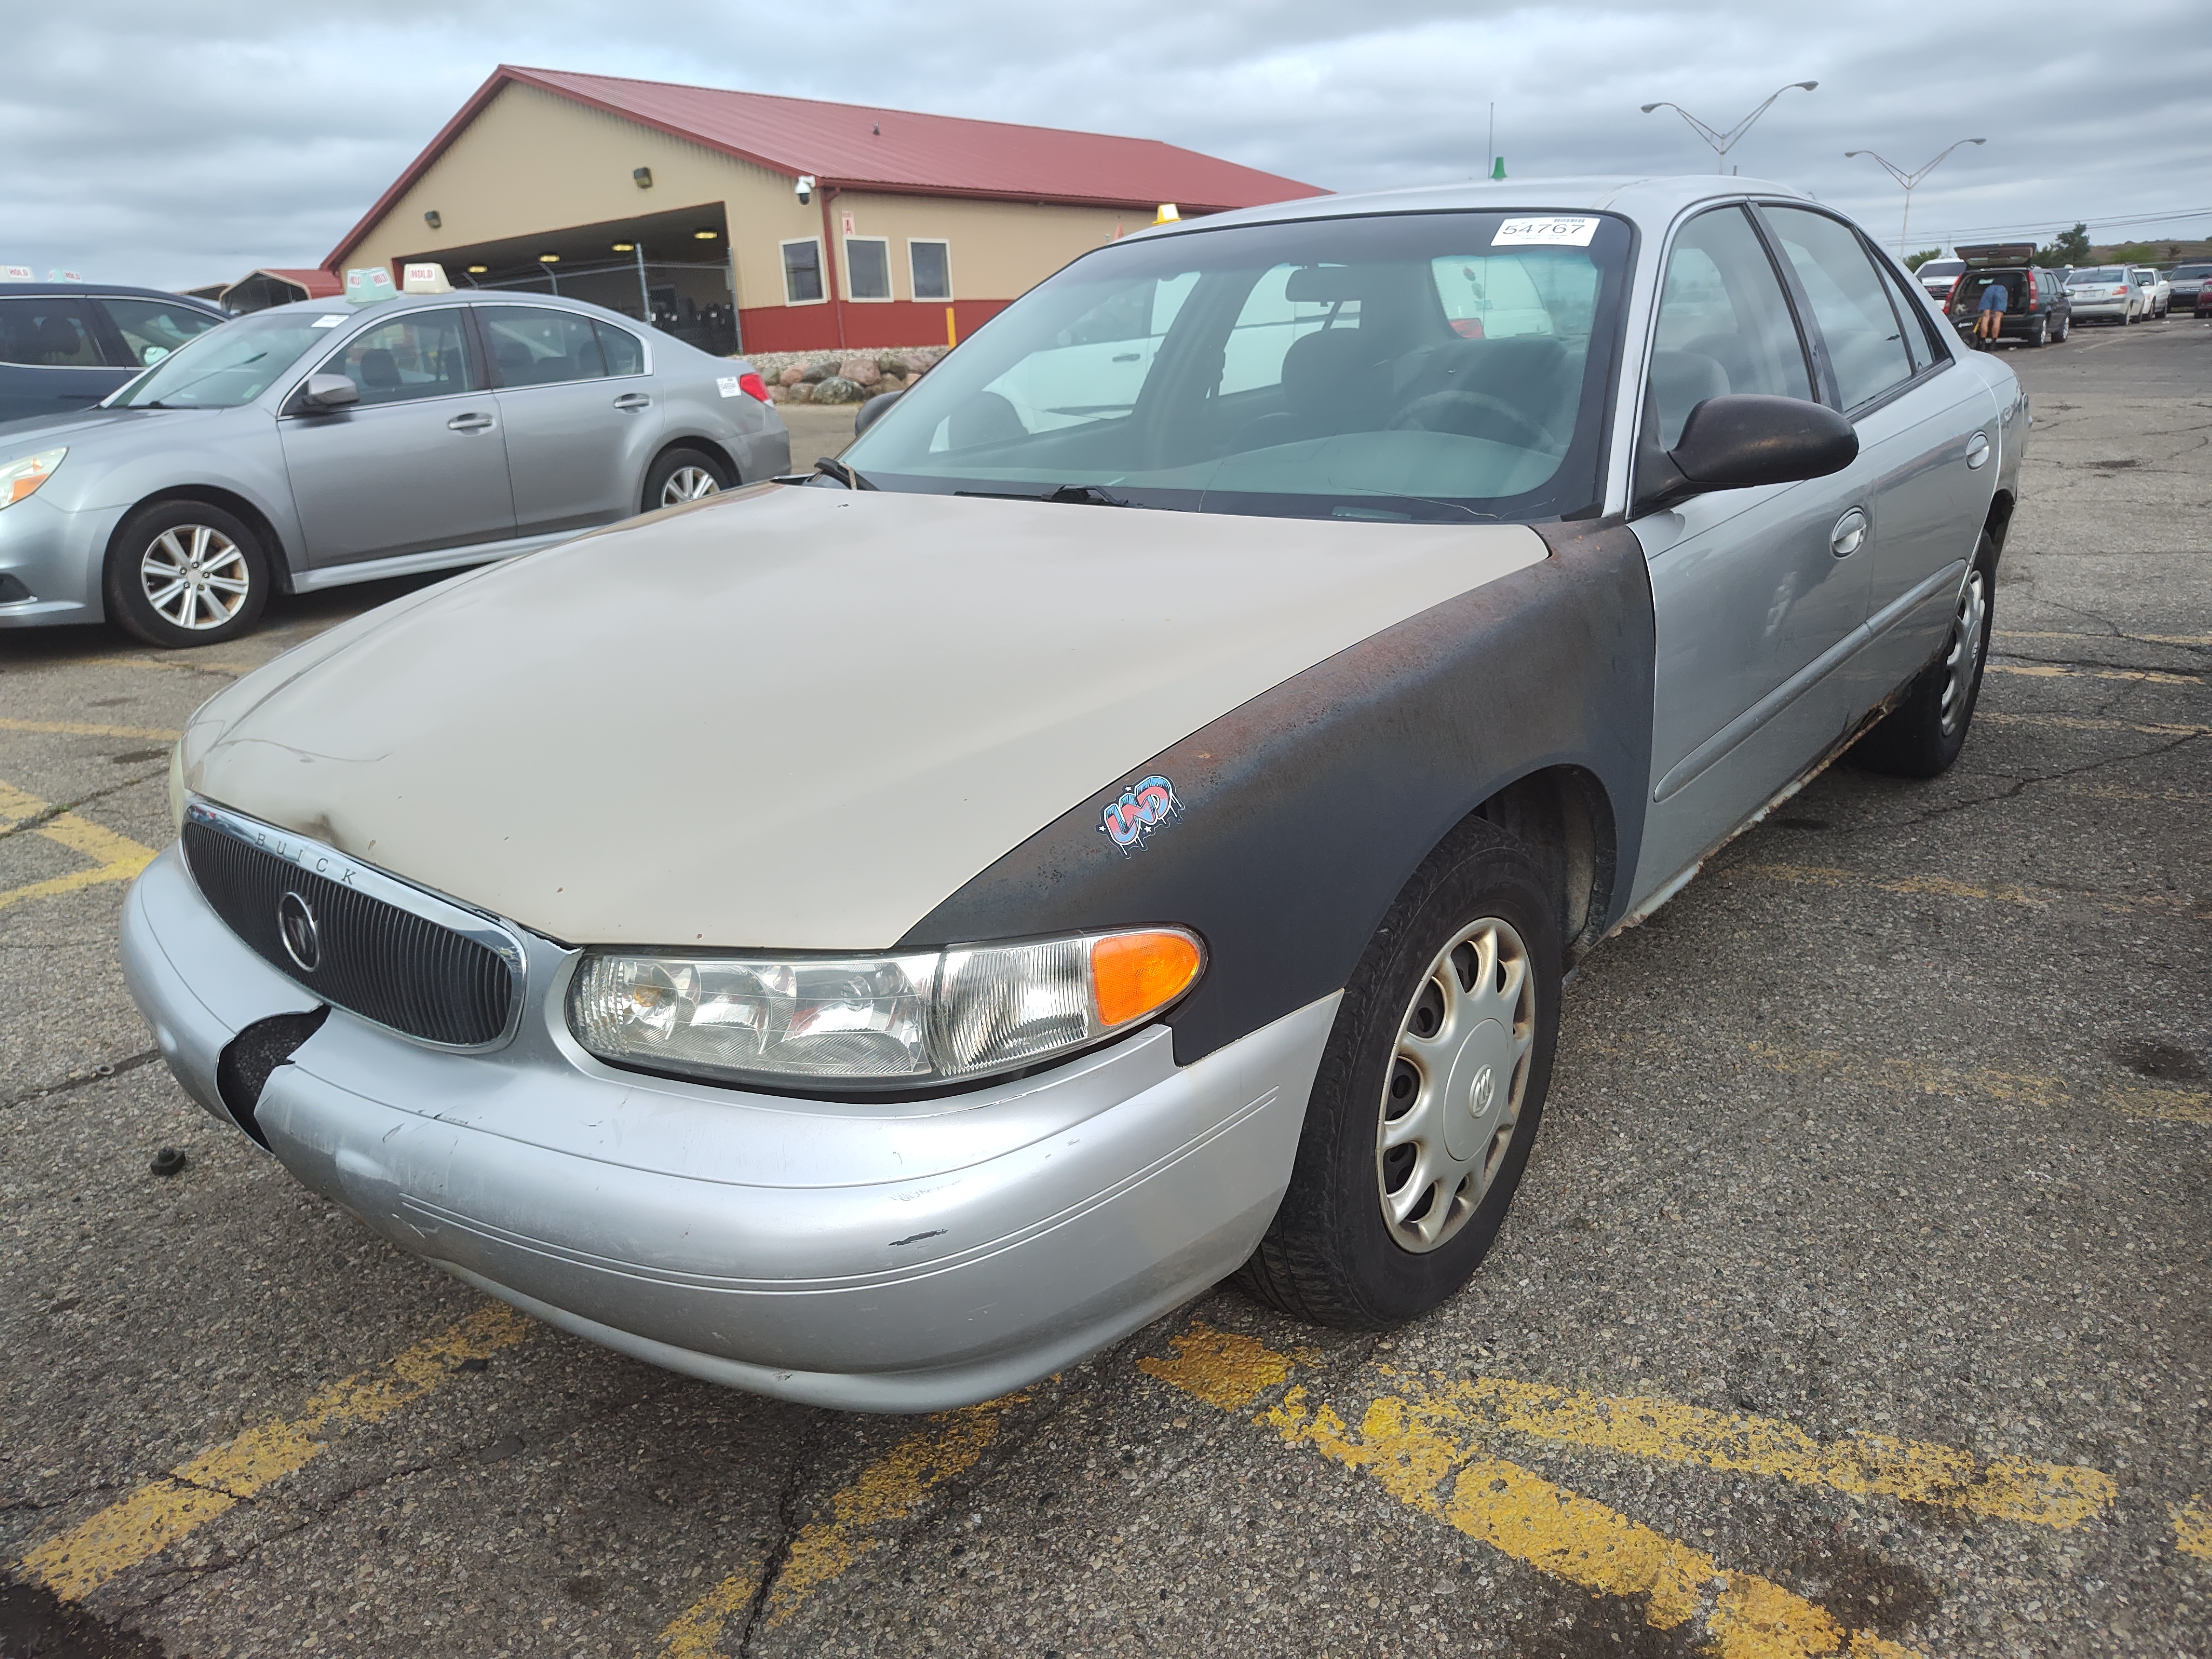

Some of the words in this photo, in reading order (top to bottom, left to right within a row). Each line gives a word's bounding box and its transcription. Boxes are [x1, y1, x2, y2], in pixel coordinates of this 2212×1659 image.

[1502, 224, 1586, 234] 54767
[410, 269, 433, 279] HOLD
[254, 832, 357, 885] BUICK
